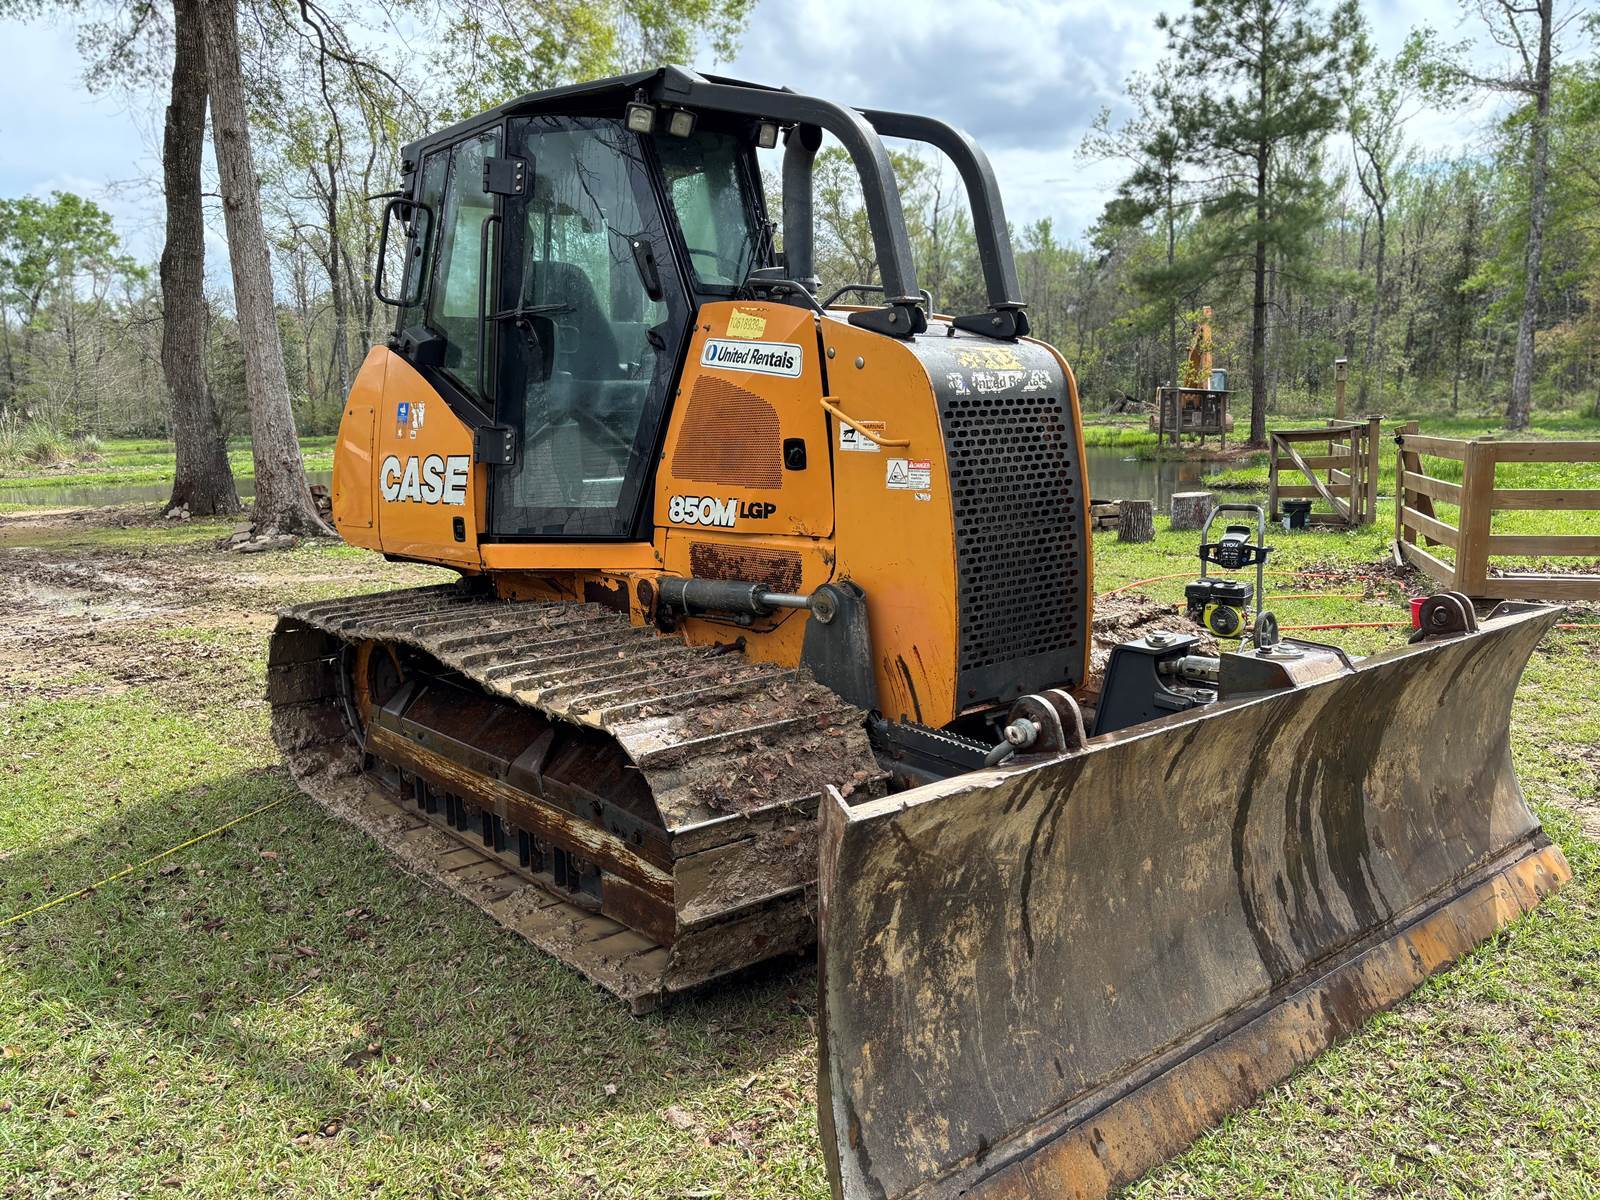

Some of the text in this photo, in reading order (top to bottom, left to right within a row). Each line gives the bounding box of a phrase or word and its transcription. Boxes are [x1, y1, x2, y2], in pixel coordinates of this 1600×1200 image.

[717, 346, 794, 369] United Rentals
[380, 454, 471, 506] CASE
[668, 495, 777, 528] 850M LGP
